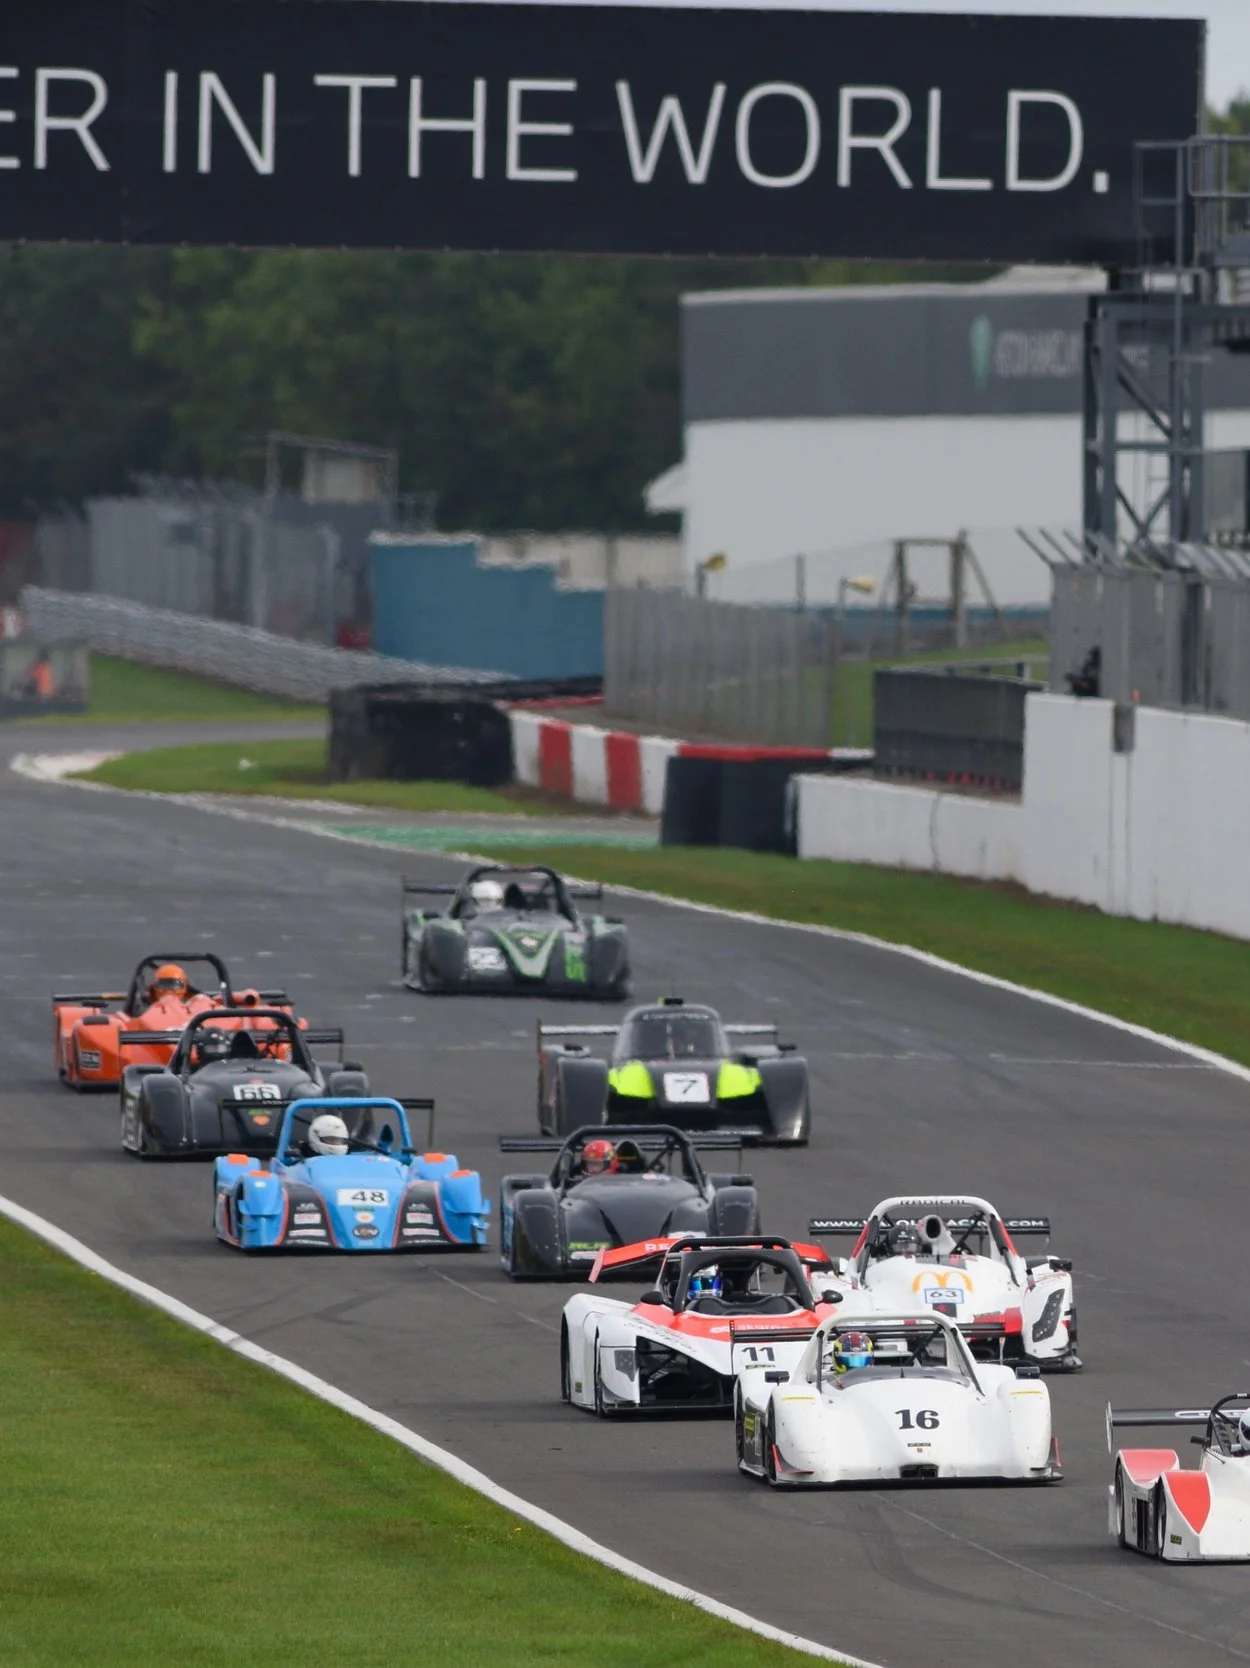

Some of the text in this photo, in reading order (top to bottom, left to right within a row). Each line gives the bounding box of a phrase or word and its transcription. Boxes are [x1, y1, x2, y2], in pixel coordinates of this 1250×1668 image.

[0, 67, 1108, 193] R IN THE WORLD.
[674, 1078, 698, 1095] 7
[351, 1190, 386, 1203] 48
[929, 1290, 958, 1299] 63
[741, 1346, 776, 1362] 11
[894, 1409, 940, 1430] 16
